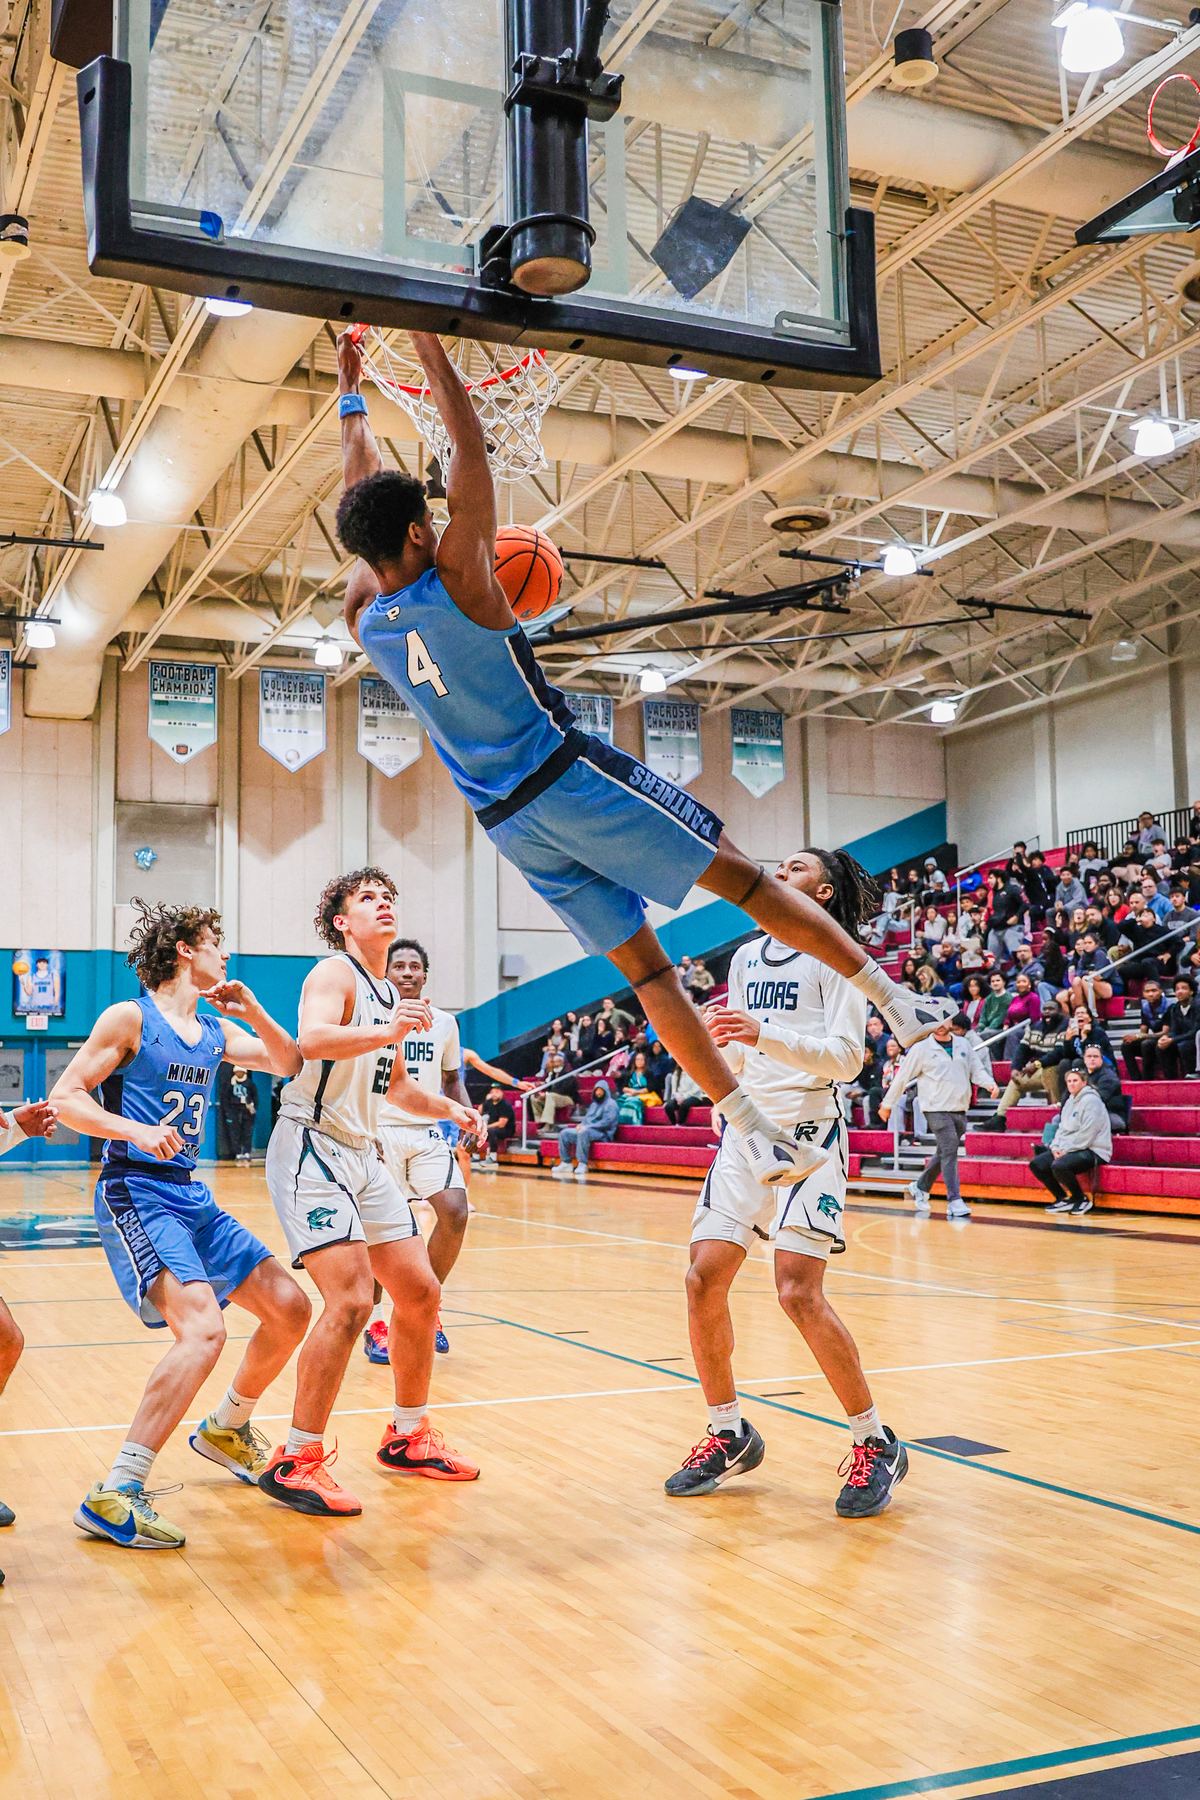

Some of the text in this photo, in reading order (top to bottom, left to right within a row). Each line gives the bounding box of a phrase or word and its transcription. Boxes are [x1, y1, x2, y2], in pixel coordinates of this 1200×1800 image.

[386, 605, 401, 622] P
[405, 627, 451, 698] 4
[152, 664, 213, 682] FOOTBALL
[152, 678, 214, 696] CHAMPIONS
[264, 679, 322, 694] VOLLEYBALL
[263, 689, 323, 705] CHAMPIONS
[362, 696, 410, 712] CHAMPIO
[647, 704, 697, 719] LACROSSE
[647, 716, 698, 731] CHAMPIONS
[733, 723, 781, 738] CHAMPIONS
[628, 765, 715, 838] PANTHERS
[746, 981, 799, 1011] CUDAS
[212, 1045, 223, 1055] P
[403, 1041, 434, 1062] DAS
[166, 1062, 210, 1086] MIAMI
[159, 1089, 205, 1137] 23
[117, 1208, 160, 1280] ANTHERS
